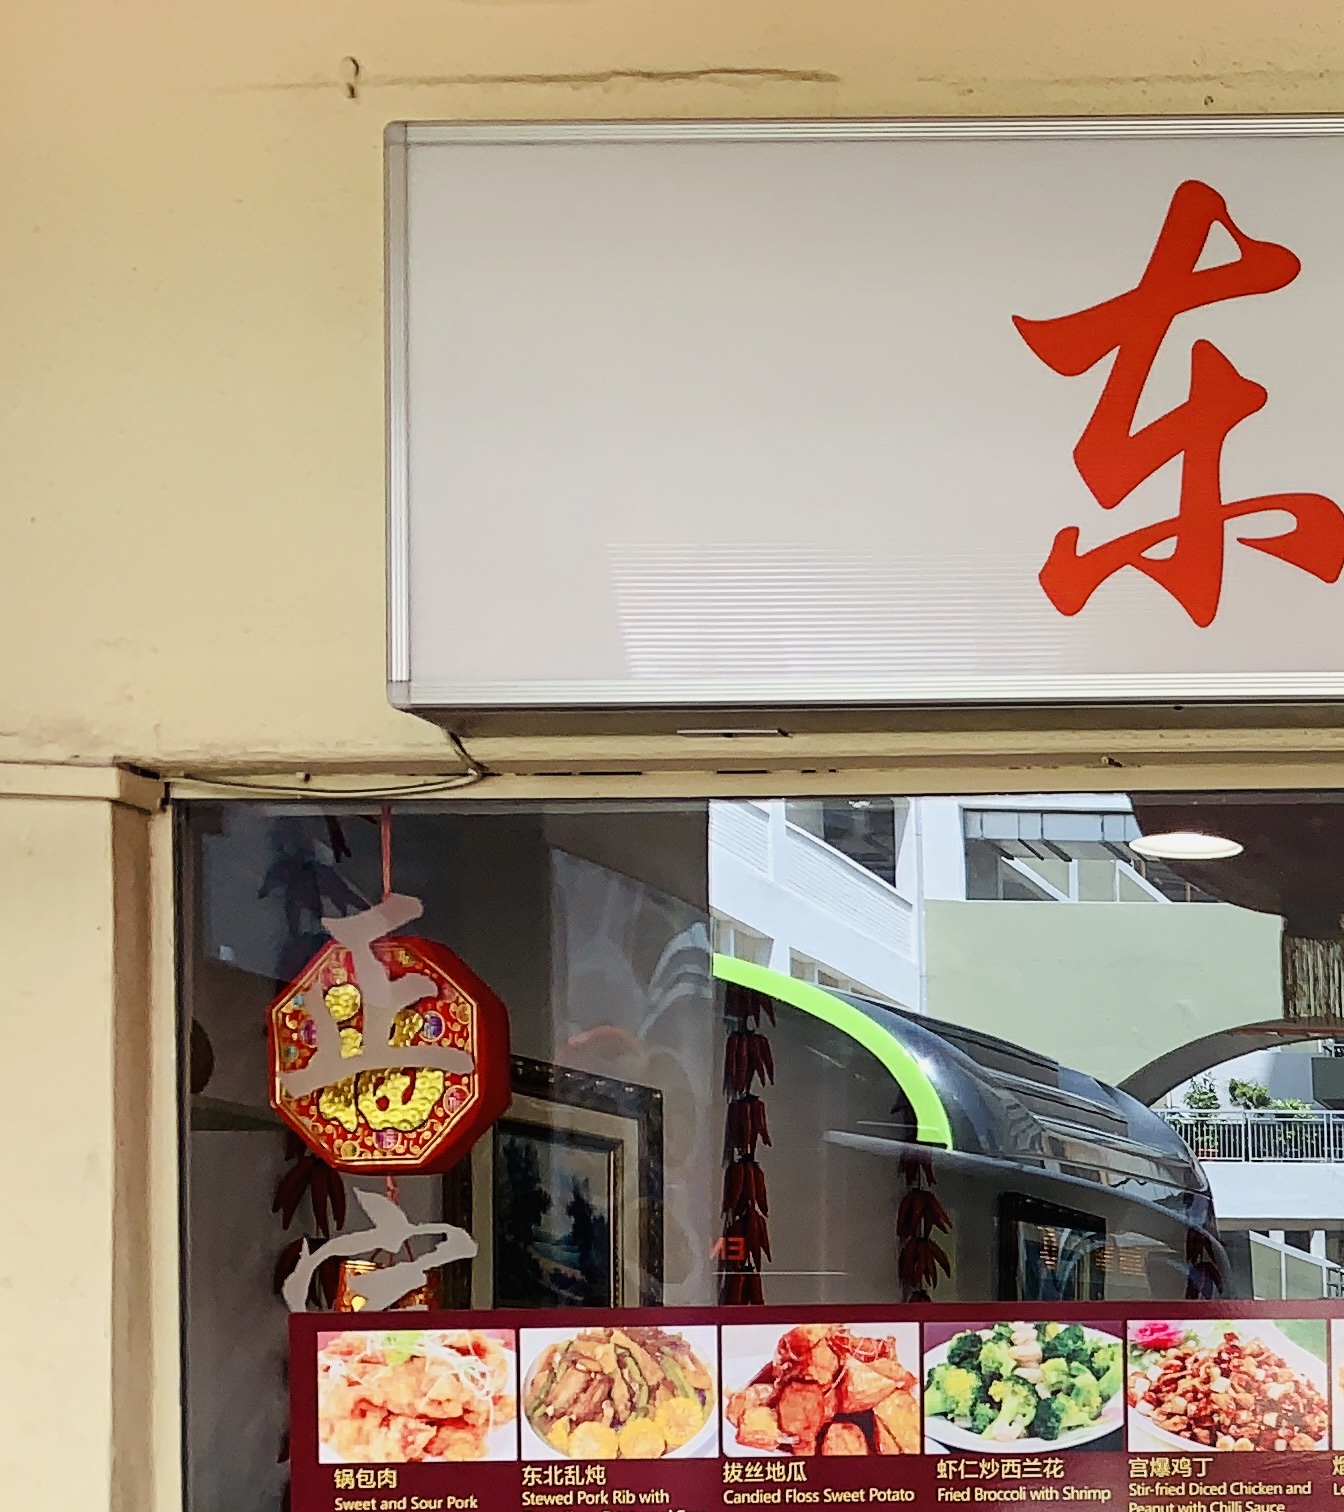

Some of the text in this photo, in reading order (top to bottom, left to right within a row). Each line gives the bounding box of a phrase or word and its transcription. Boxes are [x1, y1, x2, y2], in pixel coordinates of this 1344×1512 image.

[522, 1464, 606, 1486] 东北乱炖
[723, 1461, 807, 1483] 拔丝地瓜
[937, 1457, 1064, 1480] 虾仁炒西兰花
[1128, 1457, 1213, 1478] 宫爆鸡丁
[334, 1468, 397, 1489] 锅包肉
[522, 1489, 669, 1506] Stewed Pork Rib with
[723, 1488, 915, 1504] Candied Floss Sweet Potato
[938, 1486, 1111, 1504] Fried Broccoli with Shrimp
[1129, 1481, 1312, 1496] Stir-fried Diced Chicken and
[335, 1495, 478, 1511] Sweet and Sour Pork
